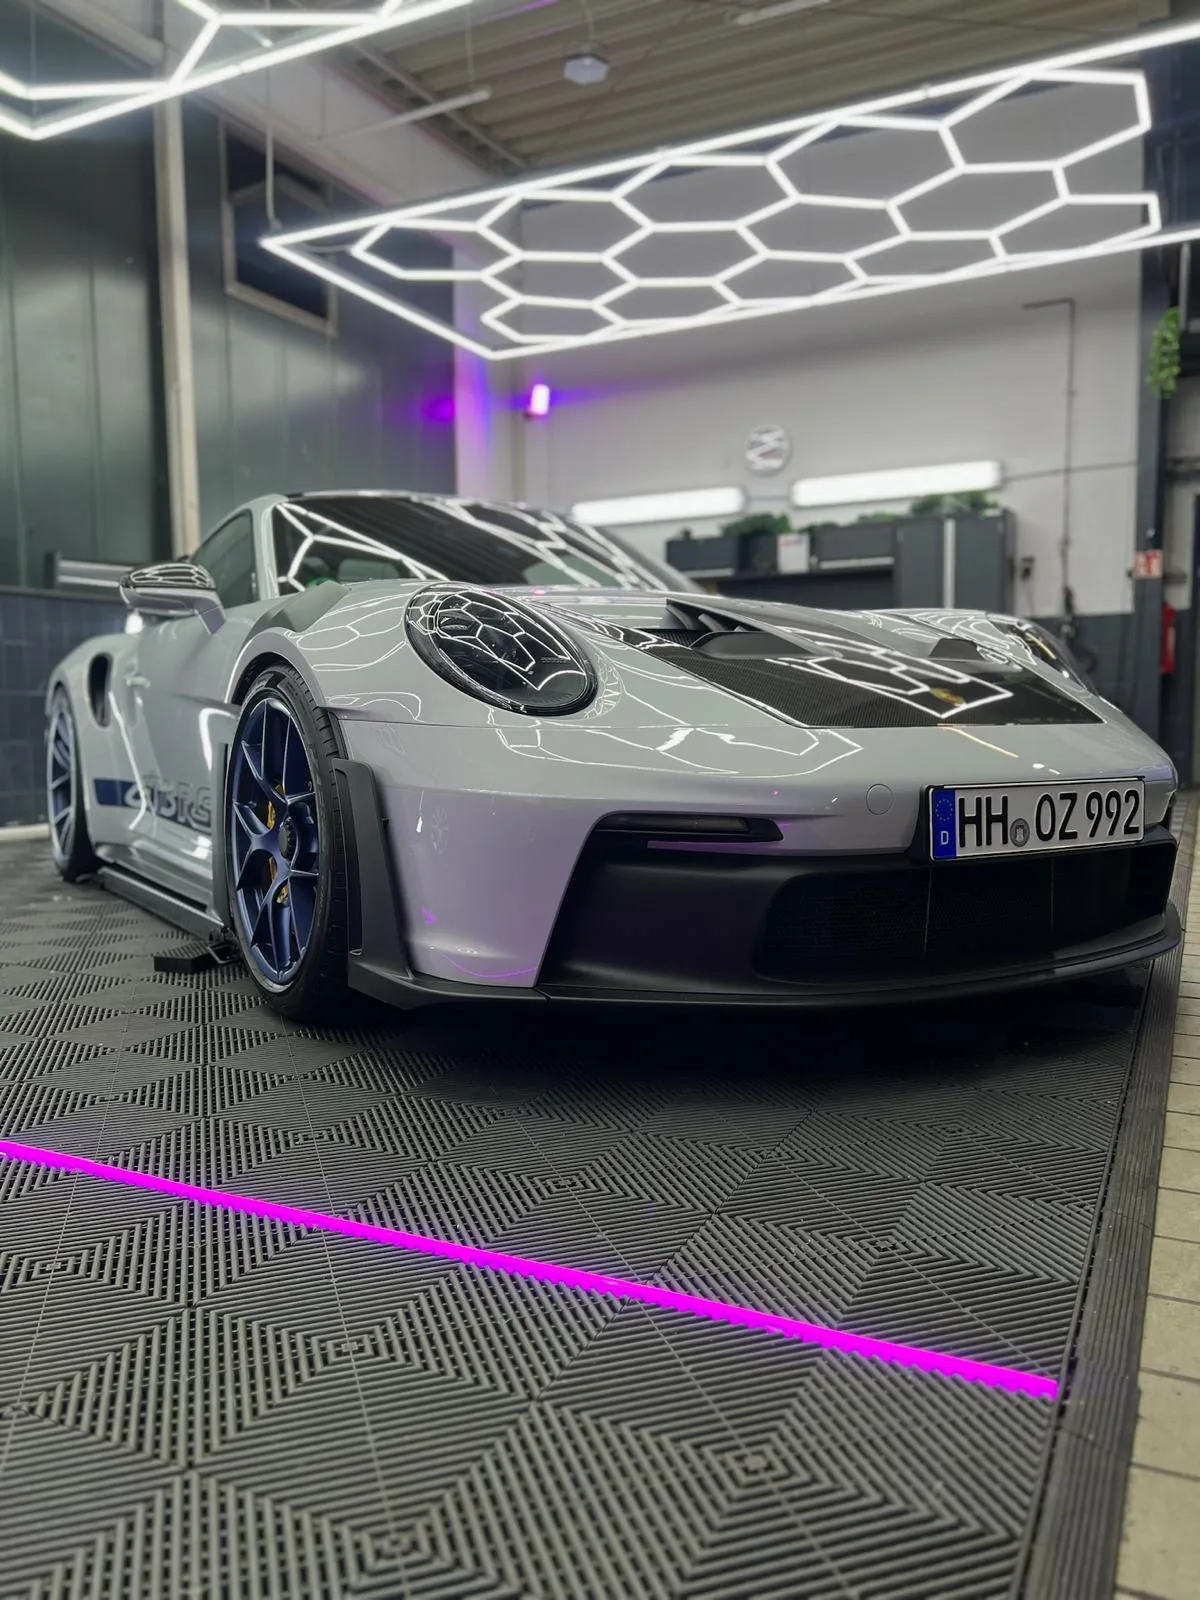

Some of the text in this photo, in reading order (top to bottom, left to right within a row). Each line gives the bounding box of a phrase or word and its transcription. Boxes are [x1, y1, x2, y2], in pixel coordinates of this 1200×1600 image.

[958, 789, 1139, 848] HH OZ 992
[940, 831, 949, 845] D
